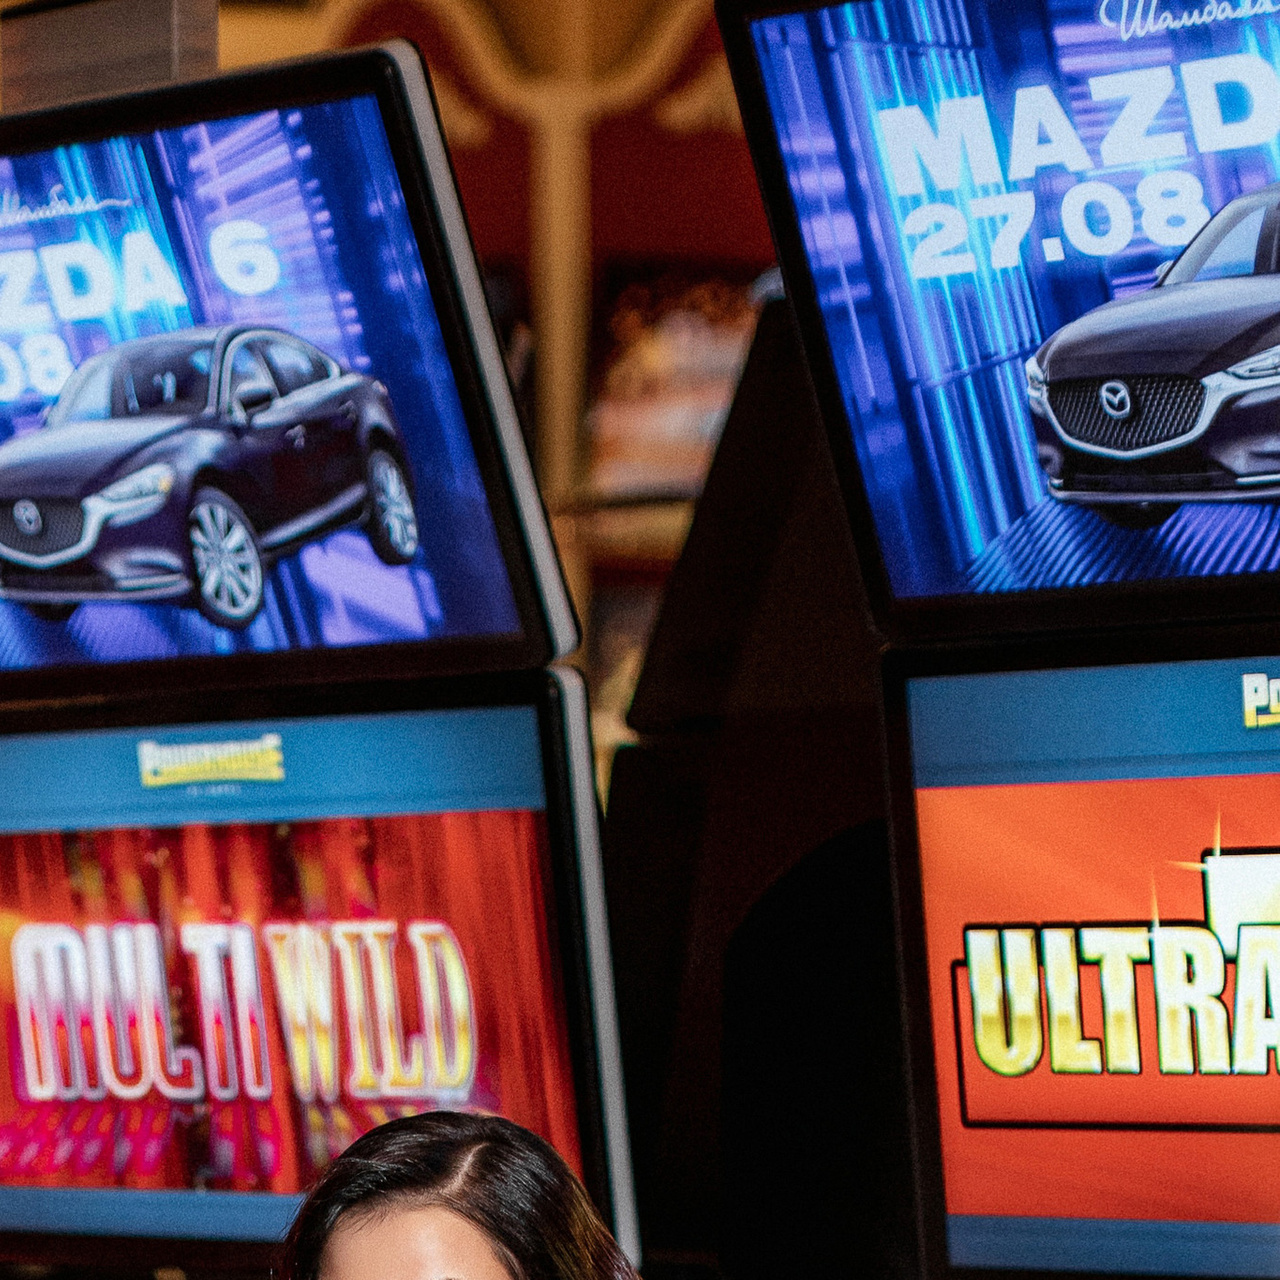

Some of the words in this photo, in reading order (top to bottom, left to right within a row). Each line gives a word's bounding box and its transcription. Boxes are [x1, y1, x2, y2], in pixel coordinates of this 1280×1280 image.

[879, 53, 1280, 196] MAZD
[209, 220, 281, 295] 6
[902, 170, 1211, 279] 27.08
[10, 920, 272, 1100] MULTI
[262, 920, 477, 1100] WILD
[965, 923, 1280, 1075] ULTRA
